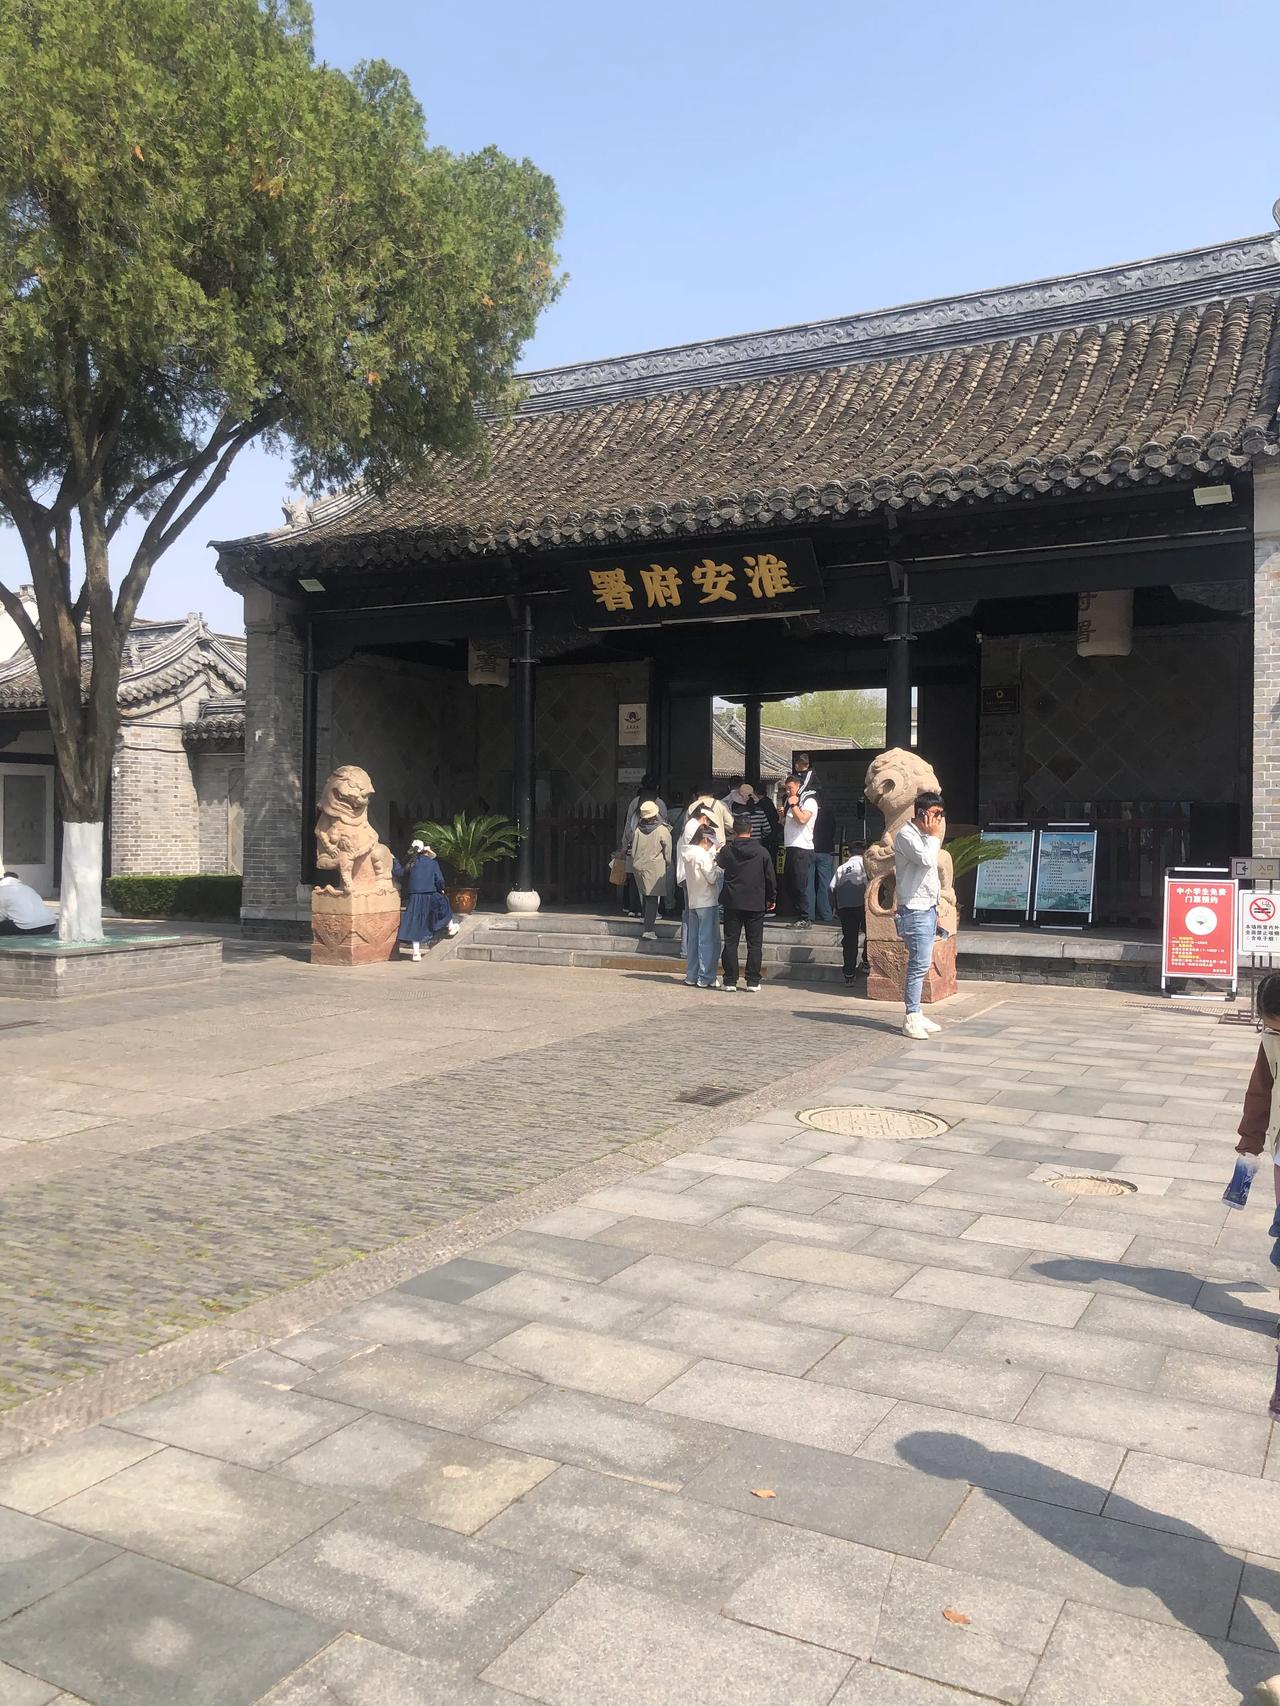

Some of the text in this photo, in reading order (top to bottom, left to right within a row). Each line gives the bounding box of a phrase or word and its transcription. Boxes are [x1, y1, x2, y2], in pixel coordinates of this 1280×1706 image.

[1259, 864, 1274, 872] 入口
[1176, 887, 1228, 896] 中小学生免费
[1184, 896, 1219, 904] 门票预约
